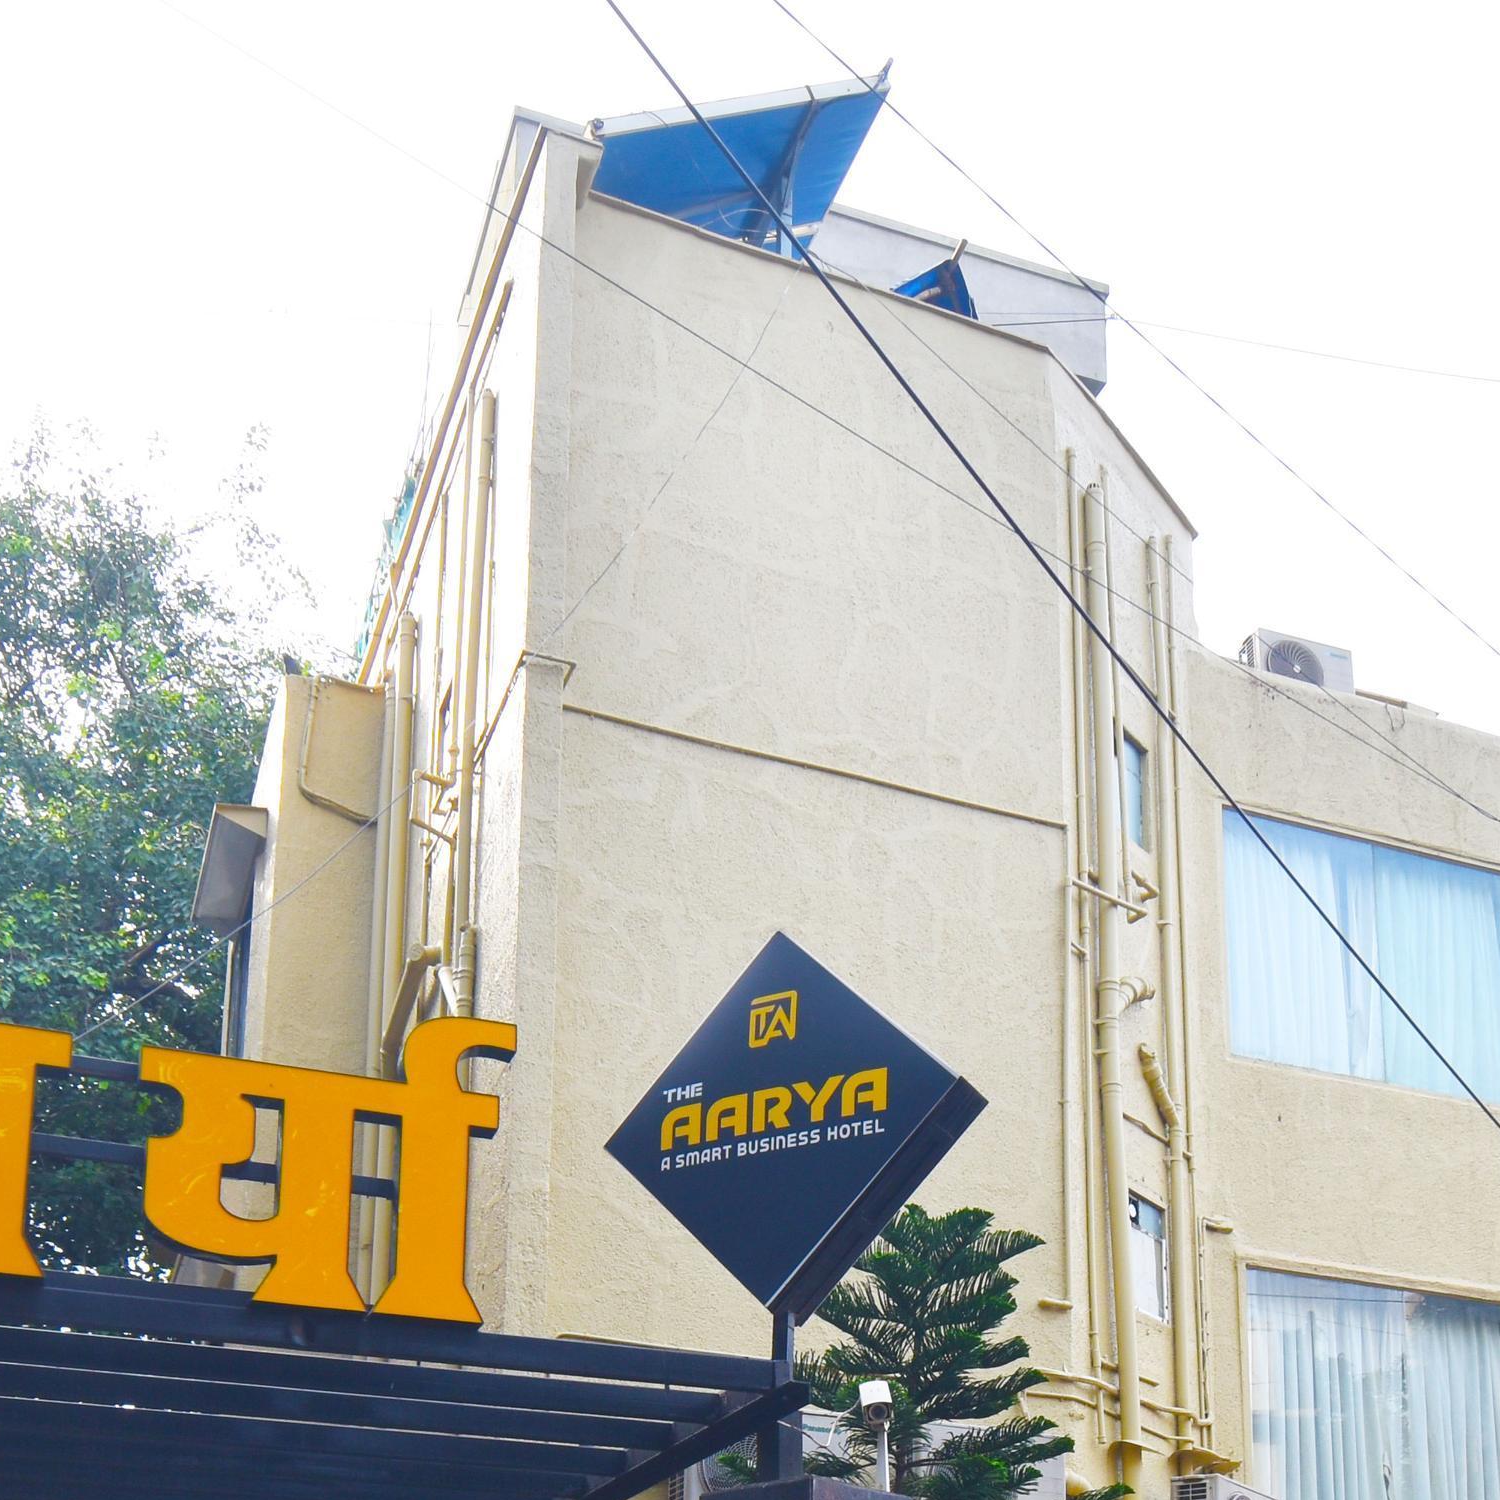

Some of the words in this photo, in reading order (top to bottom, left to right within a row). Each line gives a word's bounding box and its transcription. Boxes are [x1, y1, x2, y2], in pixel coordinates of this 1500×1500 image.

[660, 1067, 889, 1151] AARYA
[663, 1082, 703, 1103] THE
[660, 1156, 671, 1172] A
[675, 1144, 732, 1169] SMART
[737, 1129, 821, 1158] BUSINESS
[827, 1119, 886, 1141] HOTEL
